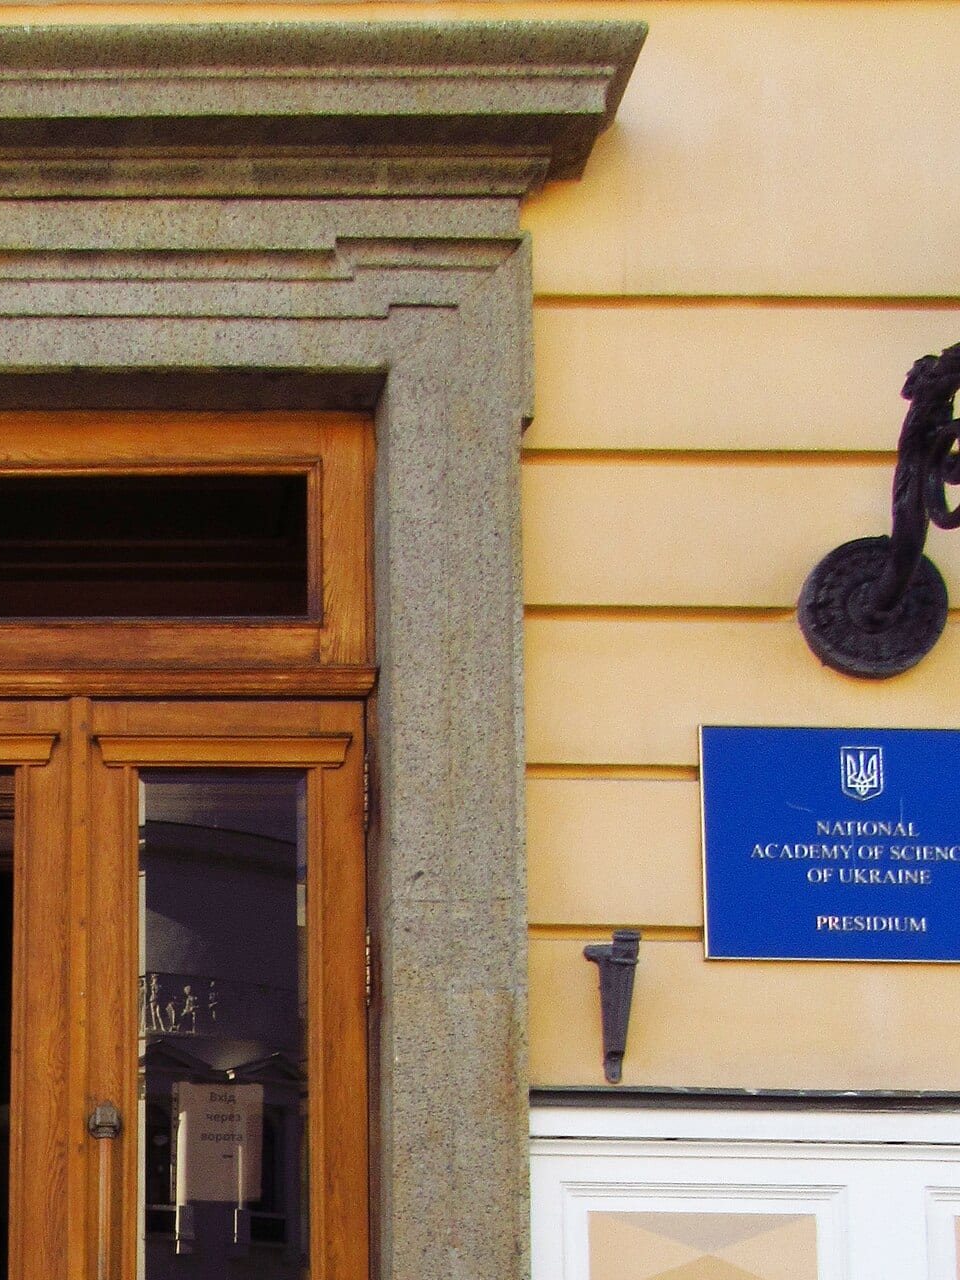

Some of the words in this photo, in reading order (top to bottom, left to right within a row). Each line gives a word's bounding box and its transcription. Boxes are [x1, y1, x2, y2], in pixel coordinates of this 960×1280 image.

[816, 821, 920, 838] NATIONAL
[751, 843, 852, 860] ACADEMY
[857, 844, 883, 860] OF
[807, 868, 833, 883] OF
[839, 868, 932, 885] UKRAINE
[816, 915, 927, 932] PRESIDIUM
[209, 1091, 236, 1104] Вхід
[206, 1113, 241, 1124] через
[200, 1132, 243, 1144] ворота
